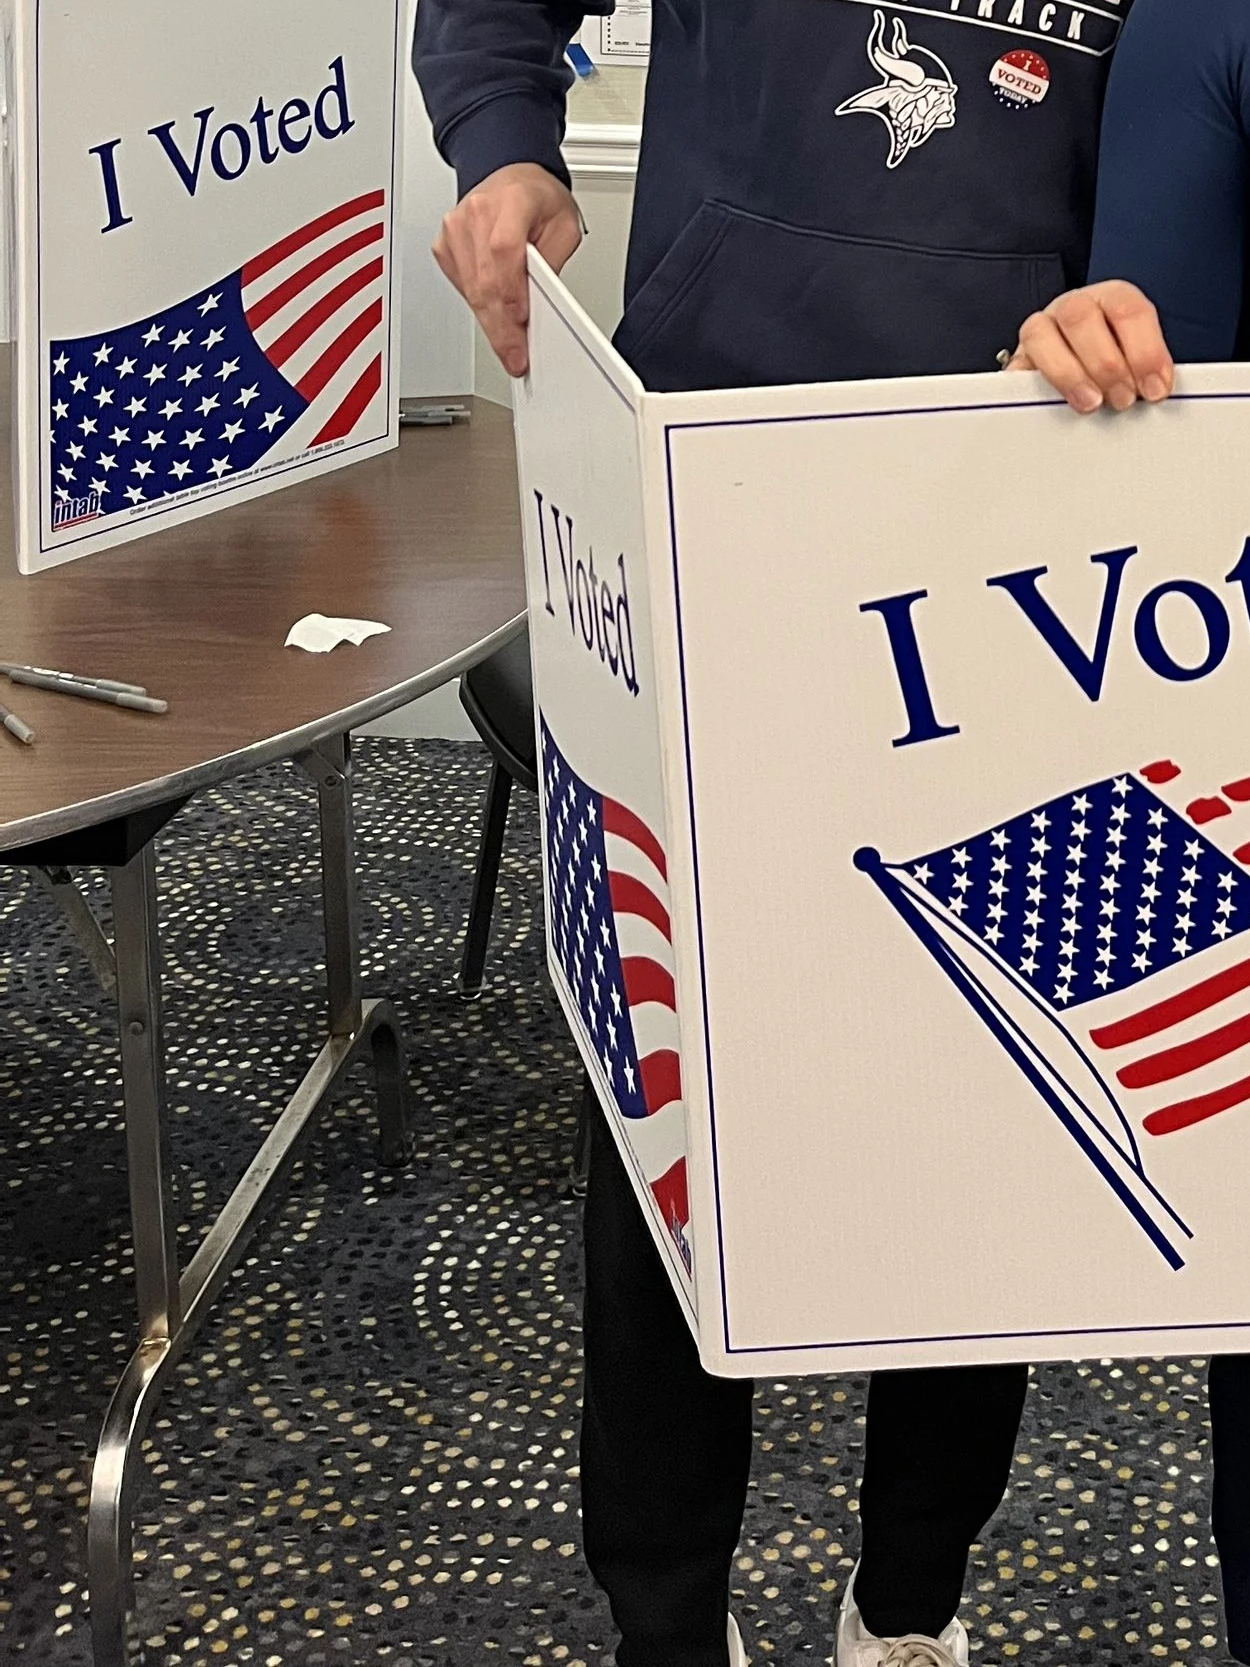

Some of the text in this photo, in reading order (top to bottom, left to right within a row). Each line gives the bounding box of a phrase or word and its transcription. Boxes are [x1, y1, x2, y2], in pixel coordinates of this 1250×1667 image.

[998, 68, 1041, 95] VOTED
[1023, 60, 1032, 71] I
[88, 55, 355, 234] I Voted
[54, 490, 101, 525] intab
[533, 488, 640, 698] I Voted
[858, 588, 961, 749] I
